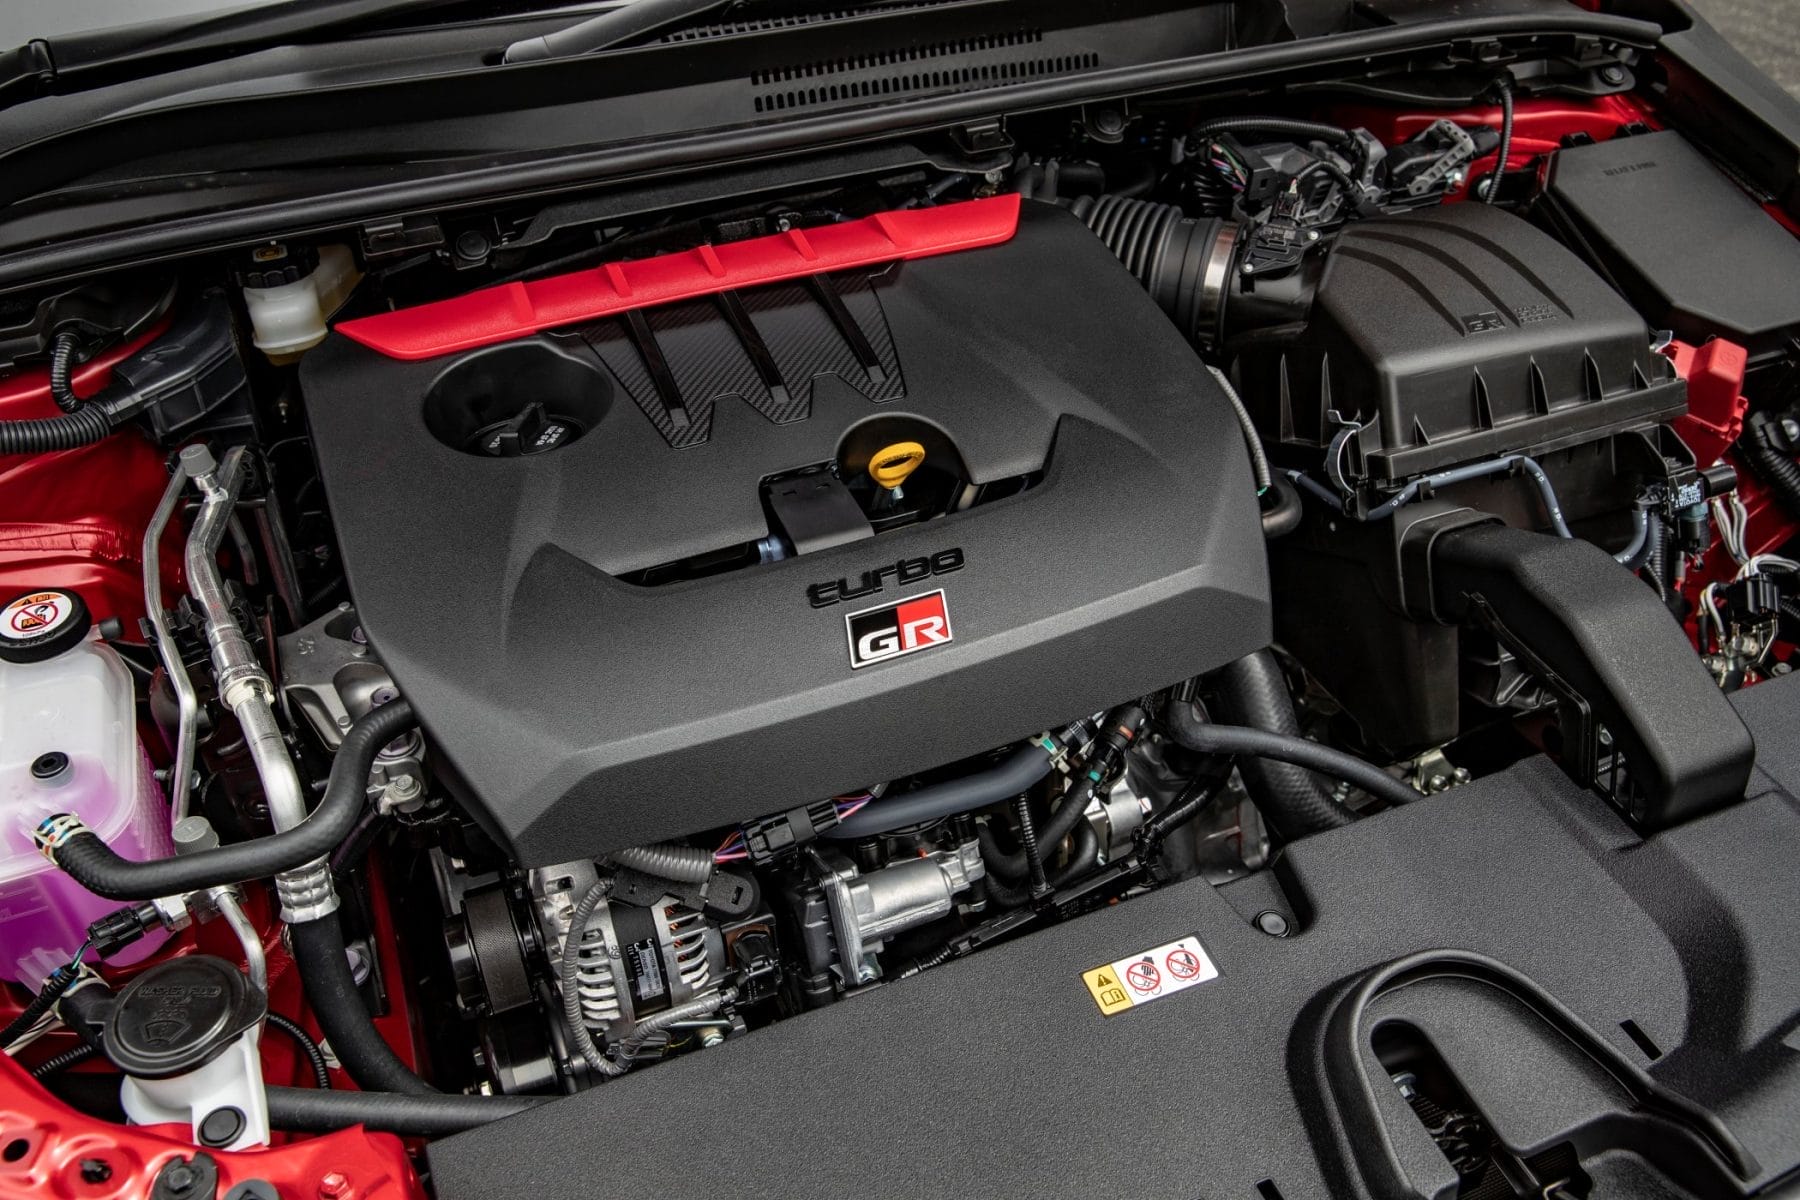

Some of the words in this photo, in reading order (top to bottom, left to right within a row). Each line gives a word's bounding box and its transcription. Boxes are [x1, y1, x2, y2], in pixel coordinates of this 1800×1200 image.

[806, 547, 965, 609] turbo
[858, 616, 947, 660] GR
[140, 985, 185, 996] WASHER
[188, 985, 218, 996] FLUID
